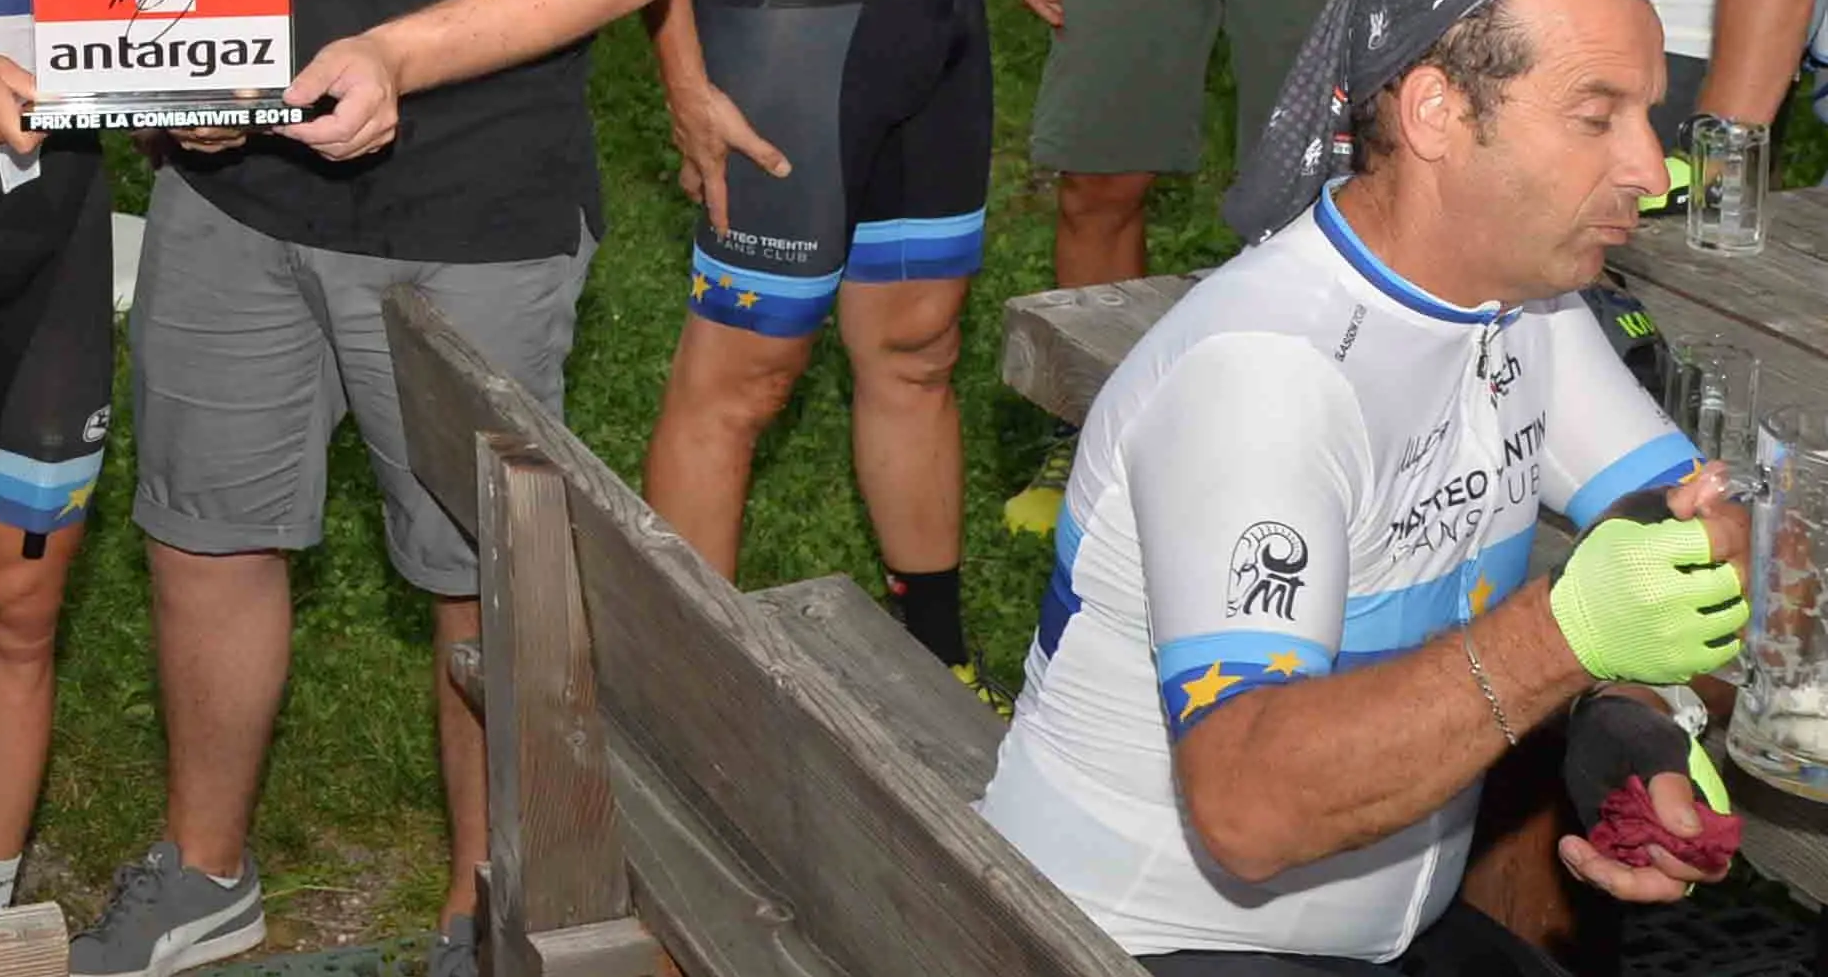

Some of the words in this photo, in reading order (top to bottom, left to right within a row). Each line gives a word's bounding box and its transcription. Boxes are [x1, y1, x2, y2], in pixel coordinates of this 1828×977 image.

[49, 34, 276, 78] antargaz
[30, 113, 71, 130] PRIX
[76, 113, 100, 129] DE
[106, 112, 129, 128] LA
[132, 109, 249, 127] COMBATIVITE
